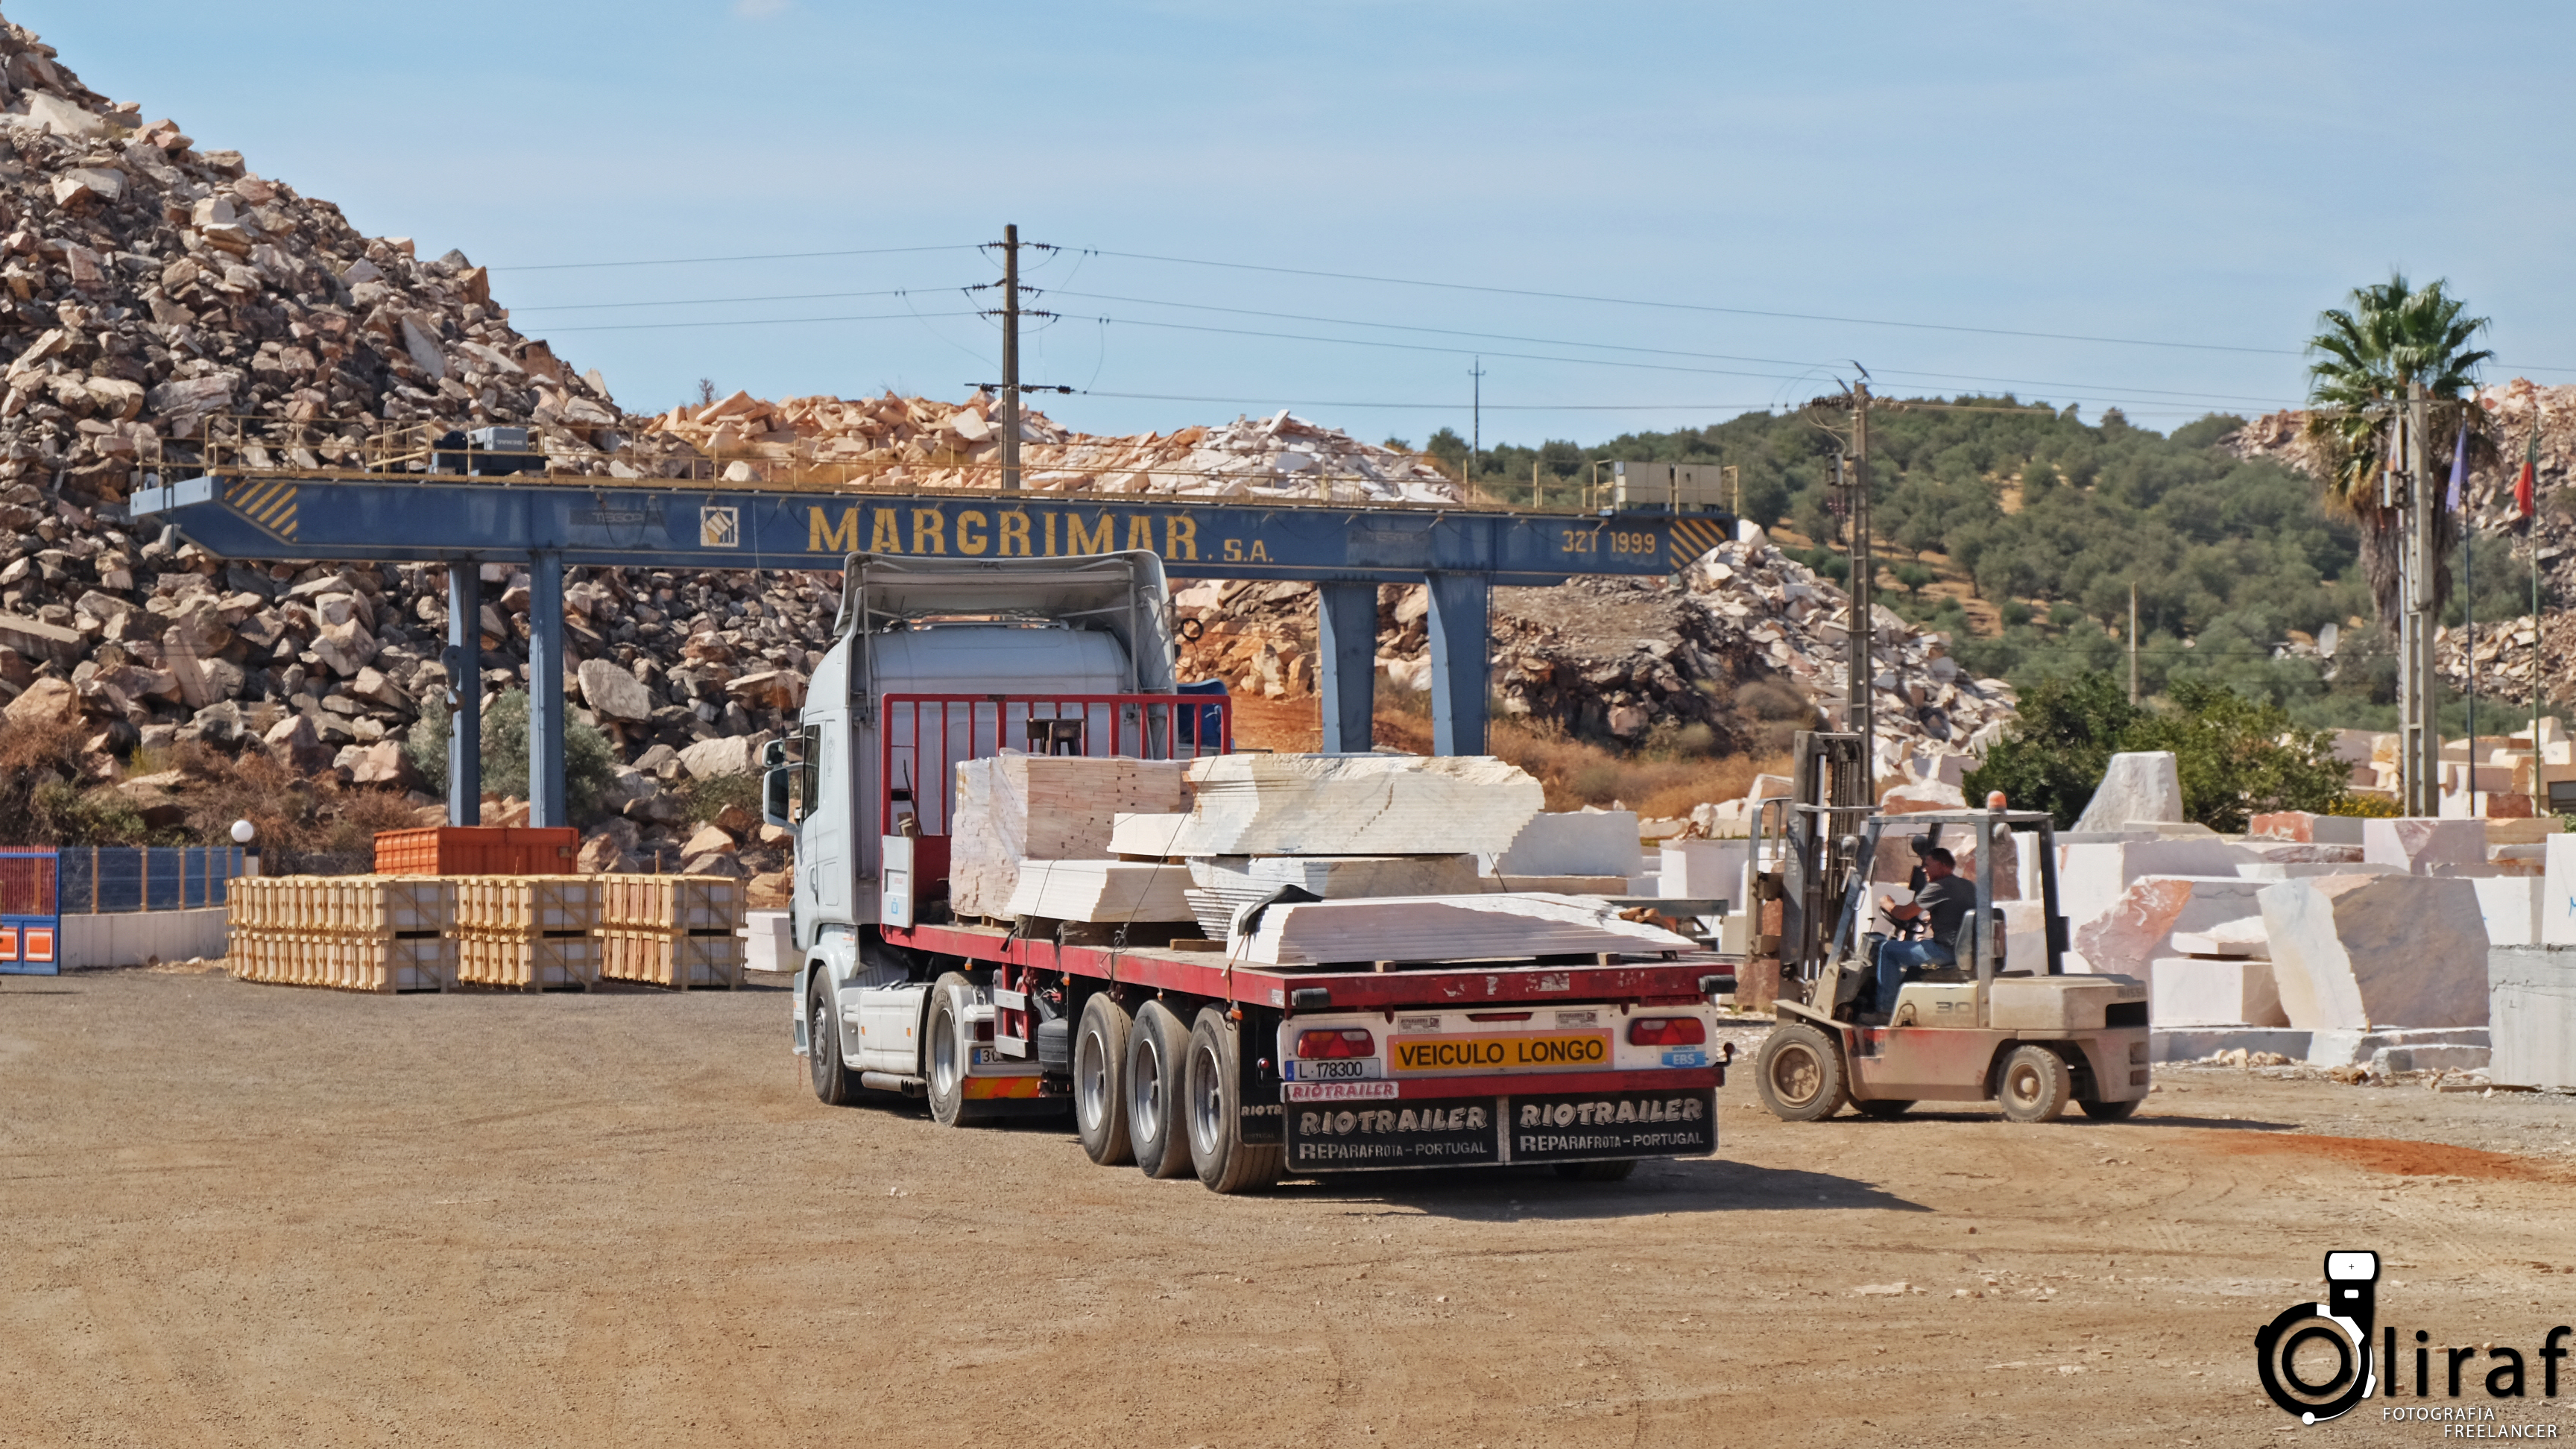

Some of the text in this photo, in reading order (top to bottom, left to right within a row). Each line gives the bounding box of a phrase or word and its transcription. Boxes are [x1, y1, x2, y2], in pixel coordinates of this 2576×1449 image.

[1223, 539, 1274, 562] S.A.
[1562, 530, 1656, 554] 32T 1999
[1936, 1001, 1972, 1014] 30
[1399, 1039, 1604, 1067] VEICULO LONGO
[1673, 1053, 1696, 1064] EBS
[1316, 1061, 1363, 1078] 178300
[1292, 1085, 1395, 1099] RIOTRAILER
[1299, 1109, 1487, 1135] RIOTRAILER
[1520, 1098, 1704, 1127] RIOTRAILER
